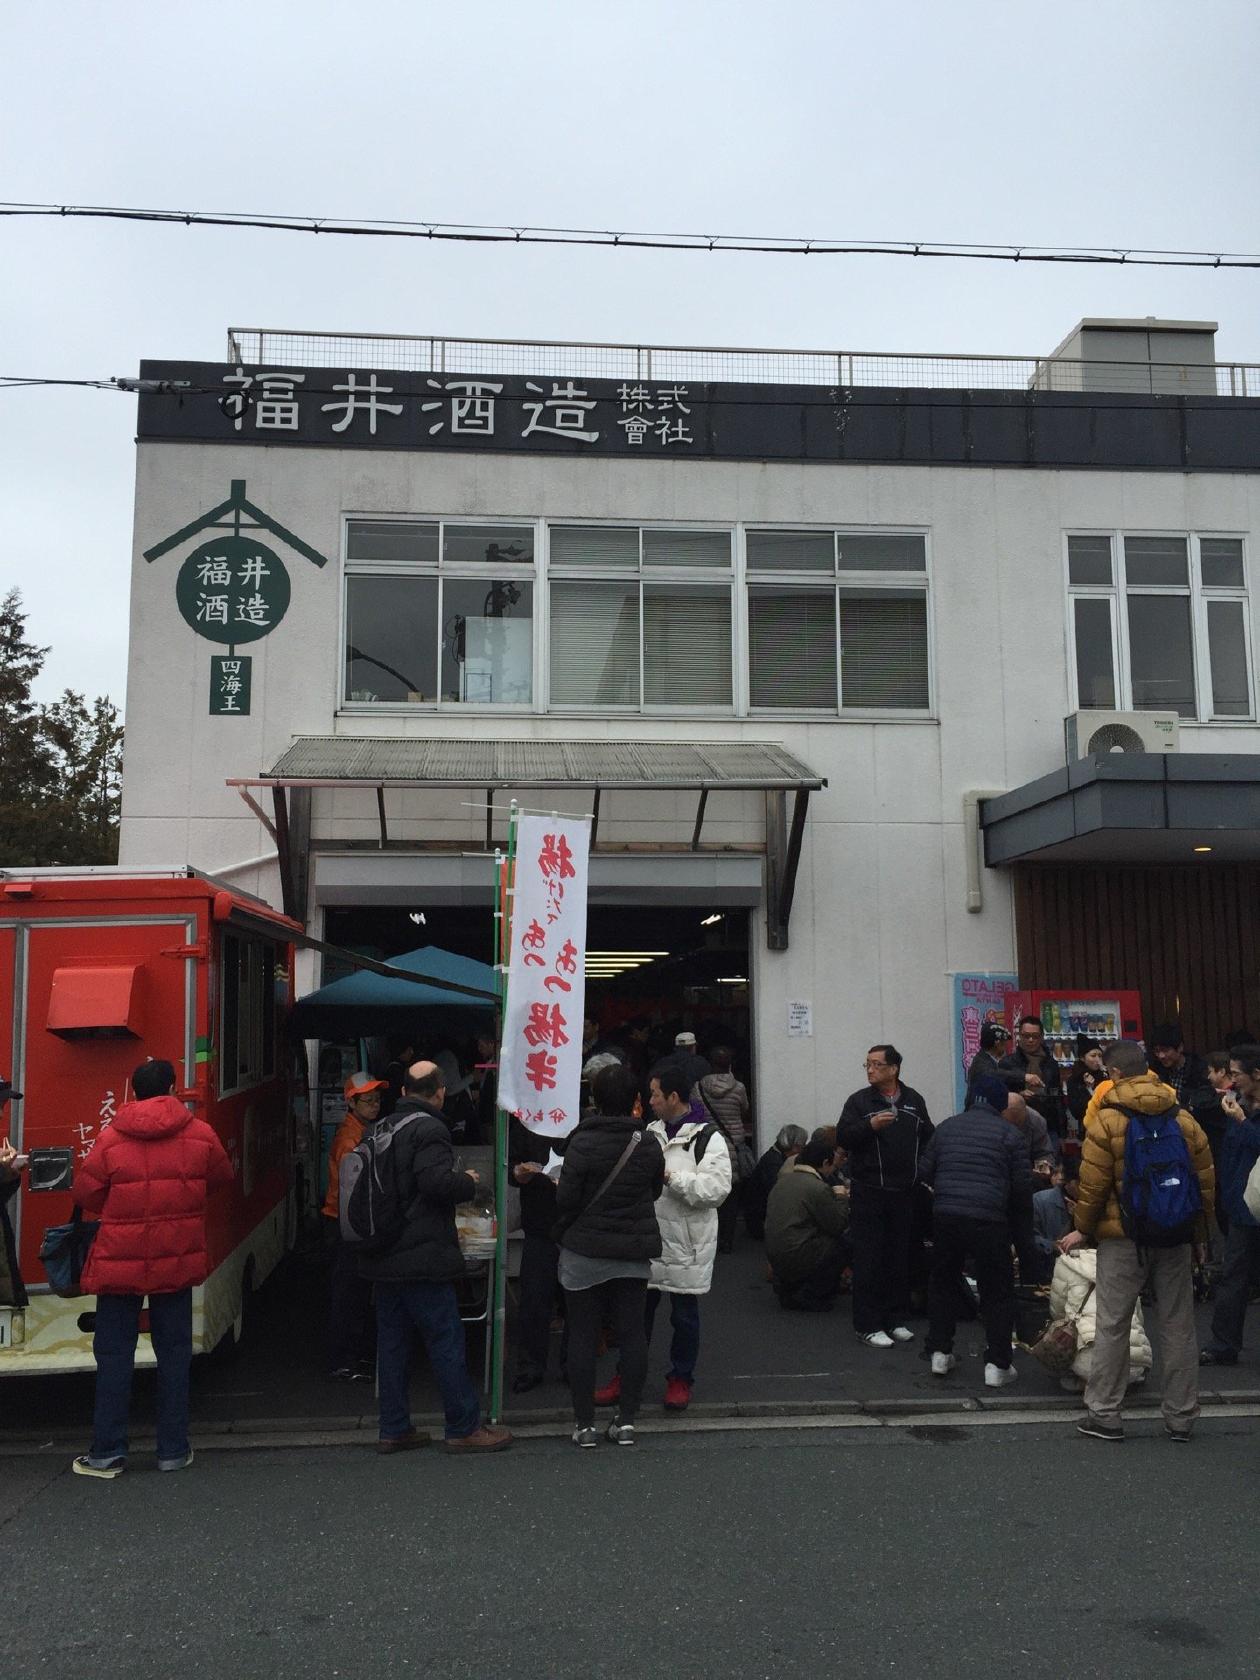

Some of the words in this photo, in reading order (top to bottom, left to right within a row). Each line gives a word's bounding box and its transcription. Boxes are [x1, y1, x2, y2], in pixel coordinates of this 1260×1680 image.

[219, 366, 600, 444] 福井酒造
[617, 382, 690, 415] 株式
[617, 415, 694, 447] 會社
[196, 555, 271, 586] 福井
[196, 592, 271, 627] 酒造
[220, 661, 242, 711] 四海王
